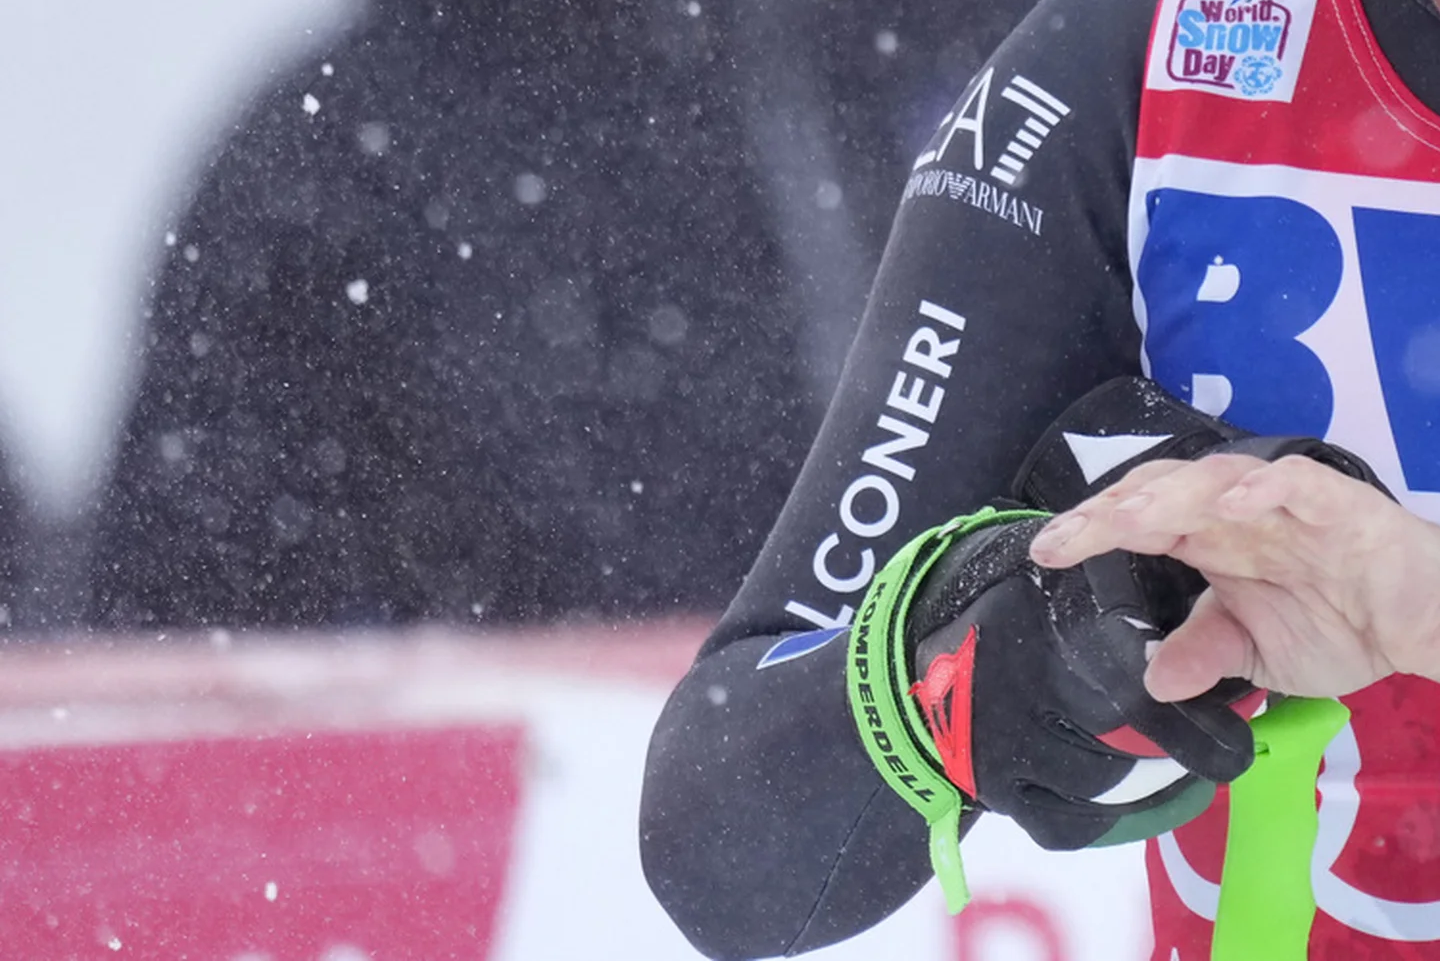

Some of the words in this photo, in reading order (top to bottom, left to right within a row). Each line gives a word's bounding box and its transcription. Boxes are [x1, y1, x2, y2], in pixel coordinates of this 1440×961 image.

[1177, 9, 1282, 54] Snow
[1182, 48, 1235, 82] Day
[963, 179, 1043, 236] ARMANI
[854, 580, 936, 804] KOMPERDELL
